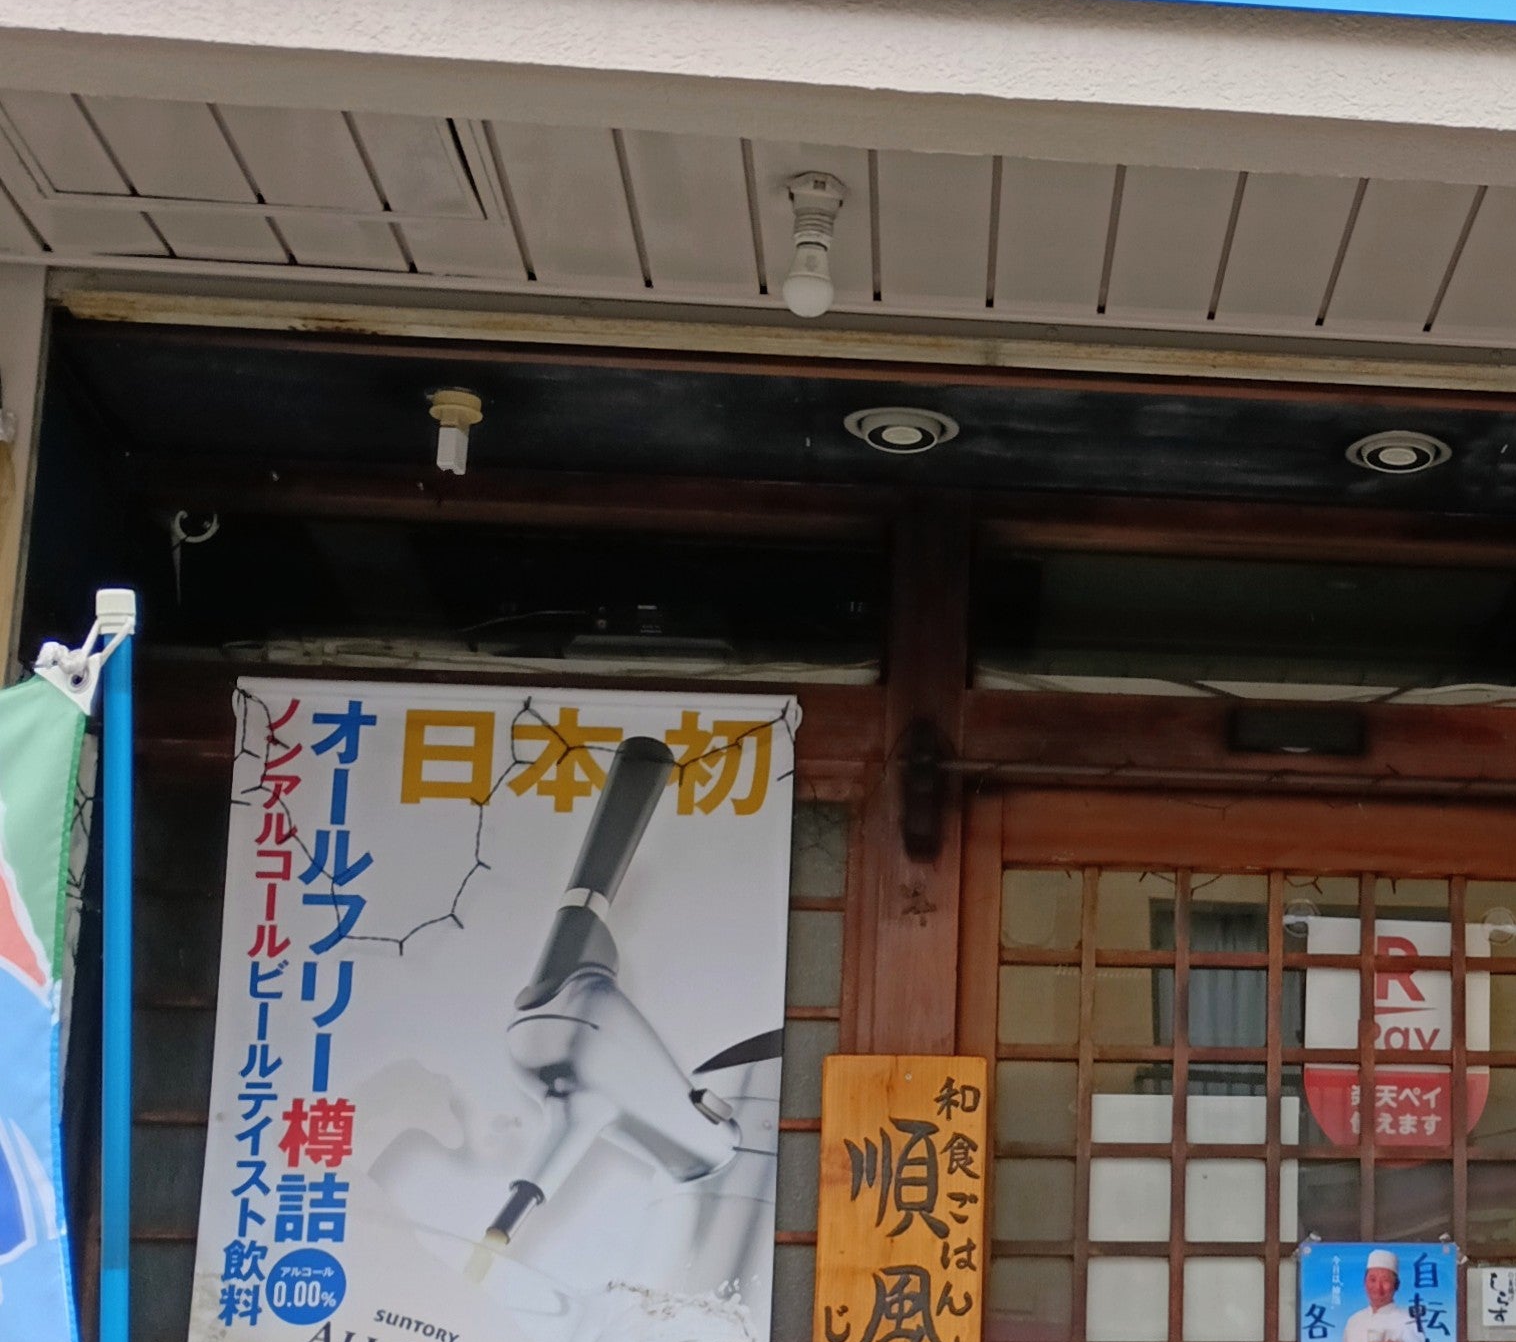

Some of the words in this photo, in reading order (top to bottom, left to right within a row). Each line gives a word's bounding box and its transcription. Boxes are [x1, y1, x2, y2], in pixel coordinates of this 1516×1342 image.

[400, 707, 772, 816] 日本初
[218, 698, 301, 1326] ノンアルコールビールテイスト飲料
[276, 699, 377, 1243] オールフリー樽詰
[280, 1266, 334, 1278] アルコール
[934, 1075, 981, 1318] 和食ごはん
[273, 1280, 336, 1308] 0.00%
